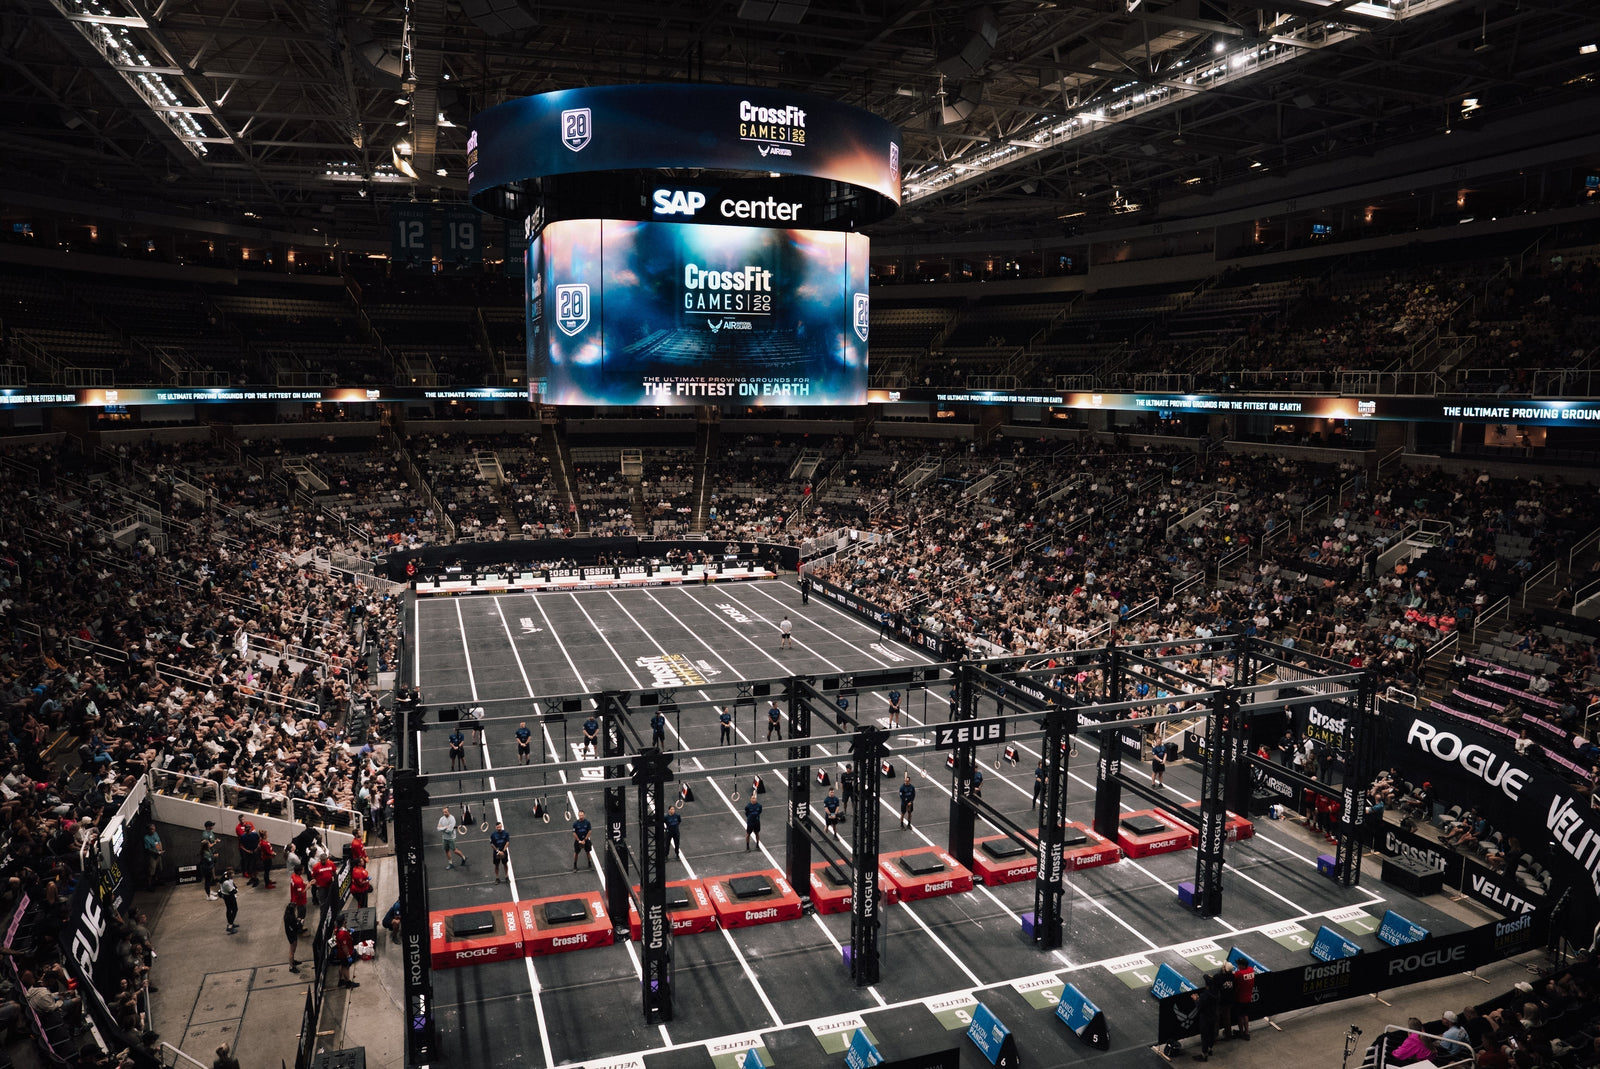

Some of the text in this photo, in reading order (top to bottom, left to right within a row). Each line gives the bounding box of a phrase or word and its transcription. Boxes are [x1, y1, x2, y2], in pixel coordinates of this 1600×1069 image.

[740, 100, 806, 127] CrossFit
[567, 114, 587, 137] 20
[740, 123, 785, 140] GAMES
[653, 189, 803, 222] SAP center
[398, 221, 424, 248] 12
[449, 222, 474, 250] 19
[685, 263, 771, 292] CrossFit
[561, 291, 583, 318] 20
[685, 292, 744, 311] GAMES
[643, 382, 810, 397] THE FITTEST ON EARTH
[1145, 399, 1168, 407] ULTIMATE
[1169, 400, 1192, 408] PROVING
[1192, 400, 1218, 409] GROUNDS
[1218, 401, 1230, 409] FOR
[1231, 401, 1242, 409] THE
[1243, 402, 1267, 410] FITTEST
[1269, 403, 1278, 411] ON
[1279, 403, 1301, 411] EARTH
[1443, 406, 1461, 416] THE
[1463, 407, 1509, 417] ULTIMATE
[1512, 408, 1558, 419] PROVING
[572, 567, 613, 576] COSSFIT
[941, 723, 1000, 745] ZEUS
[1407, 718, 1529, 802] ROGUE
[1341, 787, 1353, 824] CrossFit
[1354, 789, 1365, 825] CrossFit
[1201, 810, 1209, 853] ROGUE
[1213, 813, 1222, 854] ROGUE
[1149, 839, 1177, 850] ROGUE
[1386, 831, 1447, 872] CrossFit
[1038, 840, 1047, 881] CrossFit
[1050, 843, 1062, 883] CrossFit
[1076, 853, 1102, 865] CrossFit
[1007, 865, 1037, 877] ROGUE
[924, 880, 953, 893] CrossFit
[864, 871, 873, 917] ROGUE
[745, 908, 778, 920] CrossFit
[1332, 910, 1363, 921] VELITES
[650, 904, 662, 949] CrossFit
[672, 919, 693, 929] GUE
[1267, 925, 1299, 935] VELITES
[1355, 920, 1374, 931] 1
[1495, 914, 1531, 937] CrossFit
[607, 929, 612, 937] 9
[1289, 934, 1310, 946] 2
[1380, 931, 1400, 945] REYES
[514, 941, 523, 949] 10
[552, 934, 588, 947] CrossFit
[1315, 940, 1330, 953] LUIS
[456, 947, 498, 960] ROGUE
[1181, 943, 1215, 954] VELITES
[409, 934, 422, 986] ROGUE
[1111, 959, 1145, 970] VELITES
[1204, 954, 1224, 966] 3
[1388, 944, 1466, 976] ROGUE
[1133, 971, 1152, 983] 4
[1304, 959, 1351, 982] CrossFit
[1018, 977, 1056, 990] VELITES
[1156, 978, 1175, 996] CALUM
[1303, 977, 1336, 992] GAMES
[932, 997, 971, 1009] VELITES
[1040, 989, 1060, 1004] 5
[954, 1009, 973, 1024] 6
[817, 1019, 859, 1031] VELITES
[713, 1039, 757, 1052] VELITES
[1092, 1034, 1099, 1043] 5
[1000, 1057, 1007, 1067] 6
